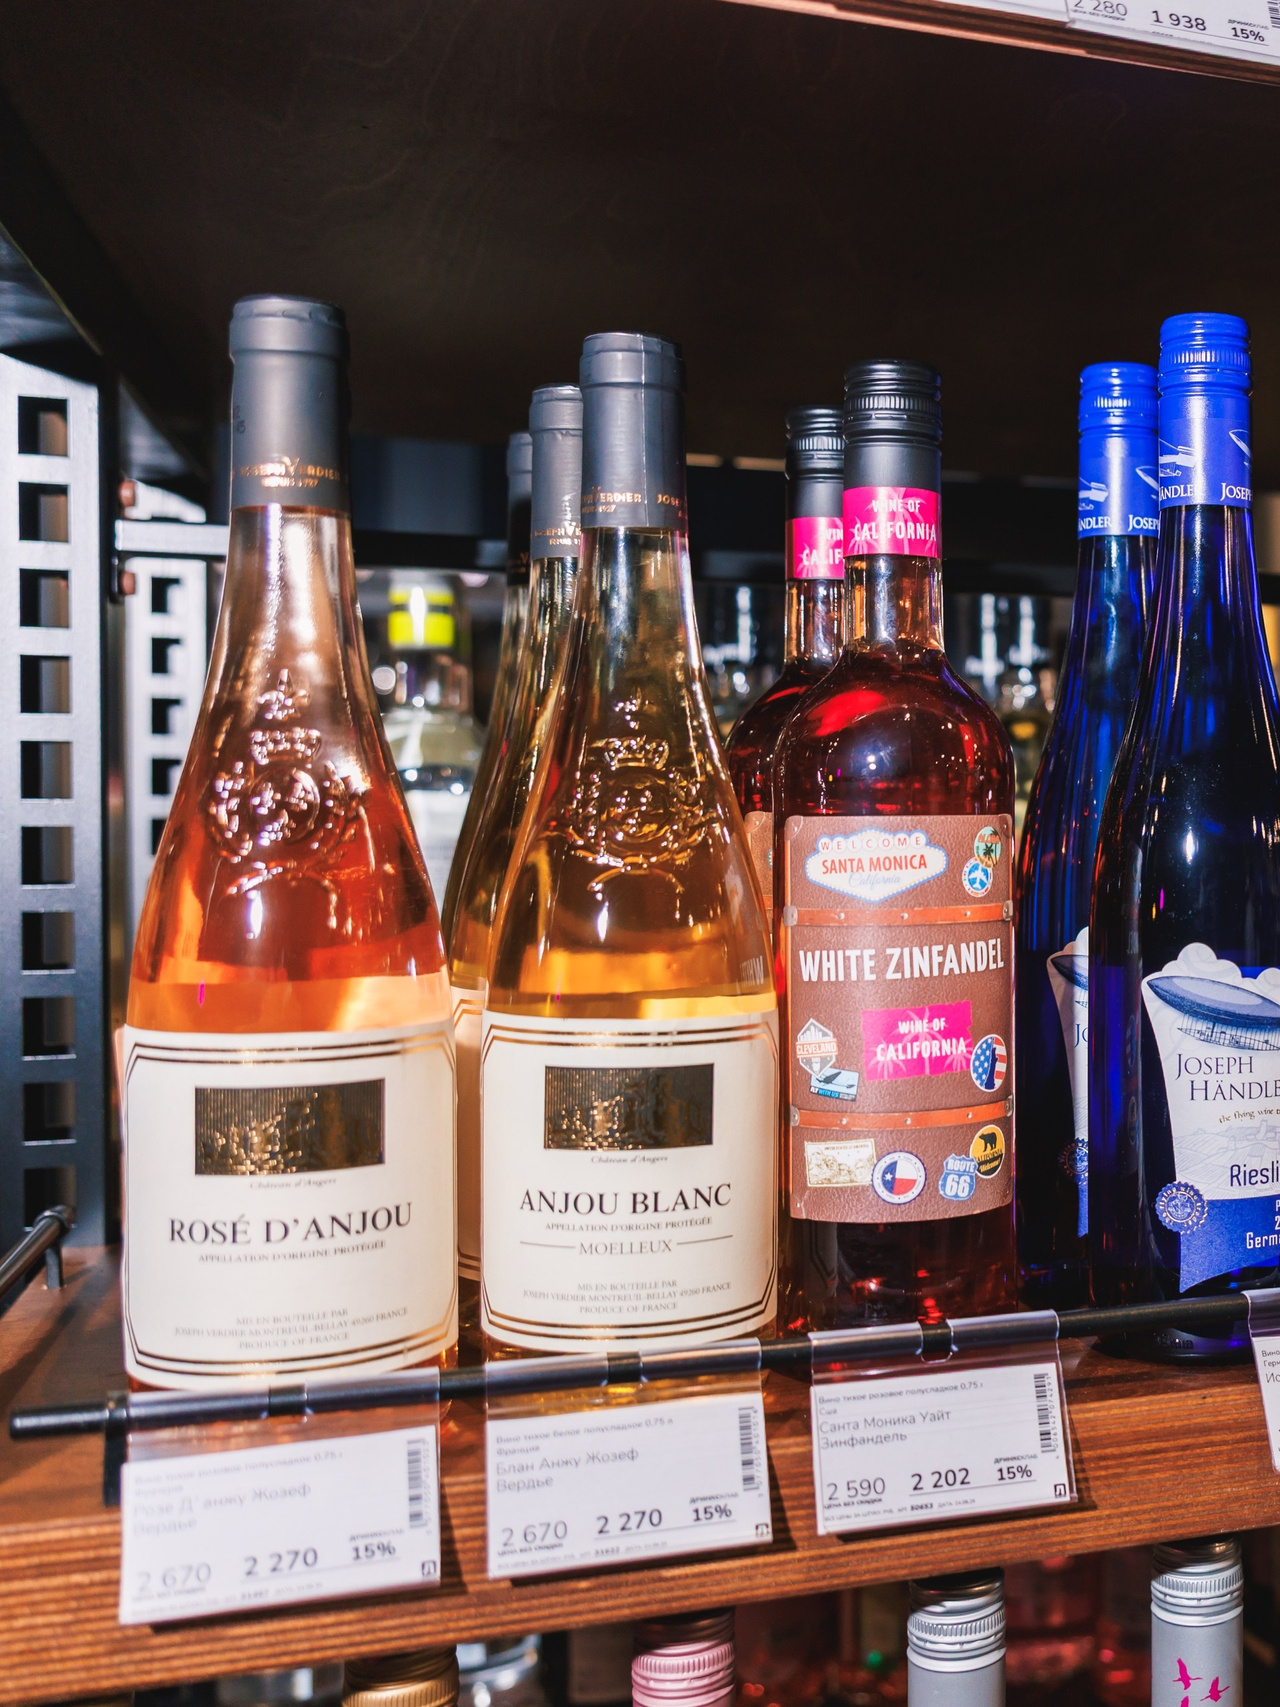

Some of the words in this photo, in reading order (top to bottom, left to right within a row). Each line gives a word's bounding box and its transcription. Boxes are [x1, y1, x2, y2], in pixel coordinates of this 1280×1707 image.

[1091, 0, 1128, 17] 280
[1152, 10, 1163, 24] 1
[1168, 13, 1207, 32] 938
[1231, 27, 1265, 42] 15%
[908, 499, 921, 512] OF
[820, 836, 921, 851] WELCOME
[821, 857, 867, 875] SANTA
[869, 854, 928, 872] MONICA
[799, 948, 877, 982] WHITE
[885, 937, 1005, 980] ZINFANDEL
[897, 1019, 930, 1035] WINE
[932, 1017, 947, 1032] OF
[796, 1041, 838, 1055] CLEVELAND
[876, 1036, 967, 1061] CALIFORNIA
[1175, 1053, 1254, 1080] JOSEPH
[1233, 1110, 1256, 1121] flying
[946, 1159, 976, 1173] ROUTE
[944, 1173, 972, 1198] 66
[519, 1188, 619, 1216] ANJOU
[630, 1183, 732, 1215] BLANC
[168, 1214, 252, 1244] ROSÉ
[265, 1202, 413, 1243] D'ANJOU
[544, 1222, 609, 1232] APPELLATION
[664, 1216, 713, 1229] PROTÉGÉE
[198, 1253, 269, 1264] APPELLATION
[333, 1240, 387, 1256] PROTÉGÉE
[579, 1239, 673, 1256] MOELLEUX
[1261, 1349, 1280, 1358] Вино
[843, 1393, 867, 1403] тихое
[868, 1389, 904, 1400] розовое
[905, 1383, 959, 1398] полусладкое
[960, 1380, 979, 1392] 0,75
[819, 1420, 860, 1435] Санта
[863, 1413, 916, 1429] Моника
[919, 1408, 952, 1424] Уайт
[820, 1431, 907, 1451] Зинфандель
[496, 1460, 535, 1476] Блан
[538, 1456, 582, 1473] Анжу
[584, 1446, 640, 1466] Жозеф
[496, 1475, 554, 1494] Вердье
[827, 1483, 839, 1501] 2
[846, 1477, 886, 1499] 590
[911, 1473, 924, 1491] 2
[931, 1467, 971, 1489] 202
[997, 1464, 1033, 1481] 15%
[502, 1527, 515, 1547] 2
[523, 1519, 568, 1544] 670
[596, 1515, 610, 1536] 2
[619, 1508, 663, 1533] 270
[691, 1503, 733, 1523] 15%
[244, 1557, 260, 1578] 2
[269, 1546, 319, 1574] 270
[351, 1541, 397, 1562] 15%
